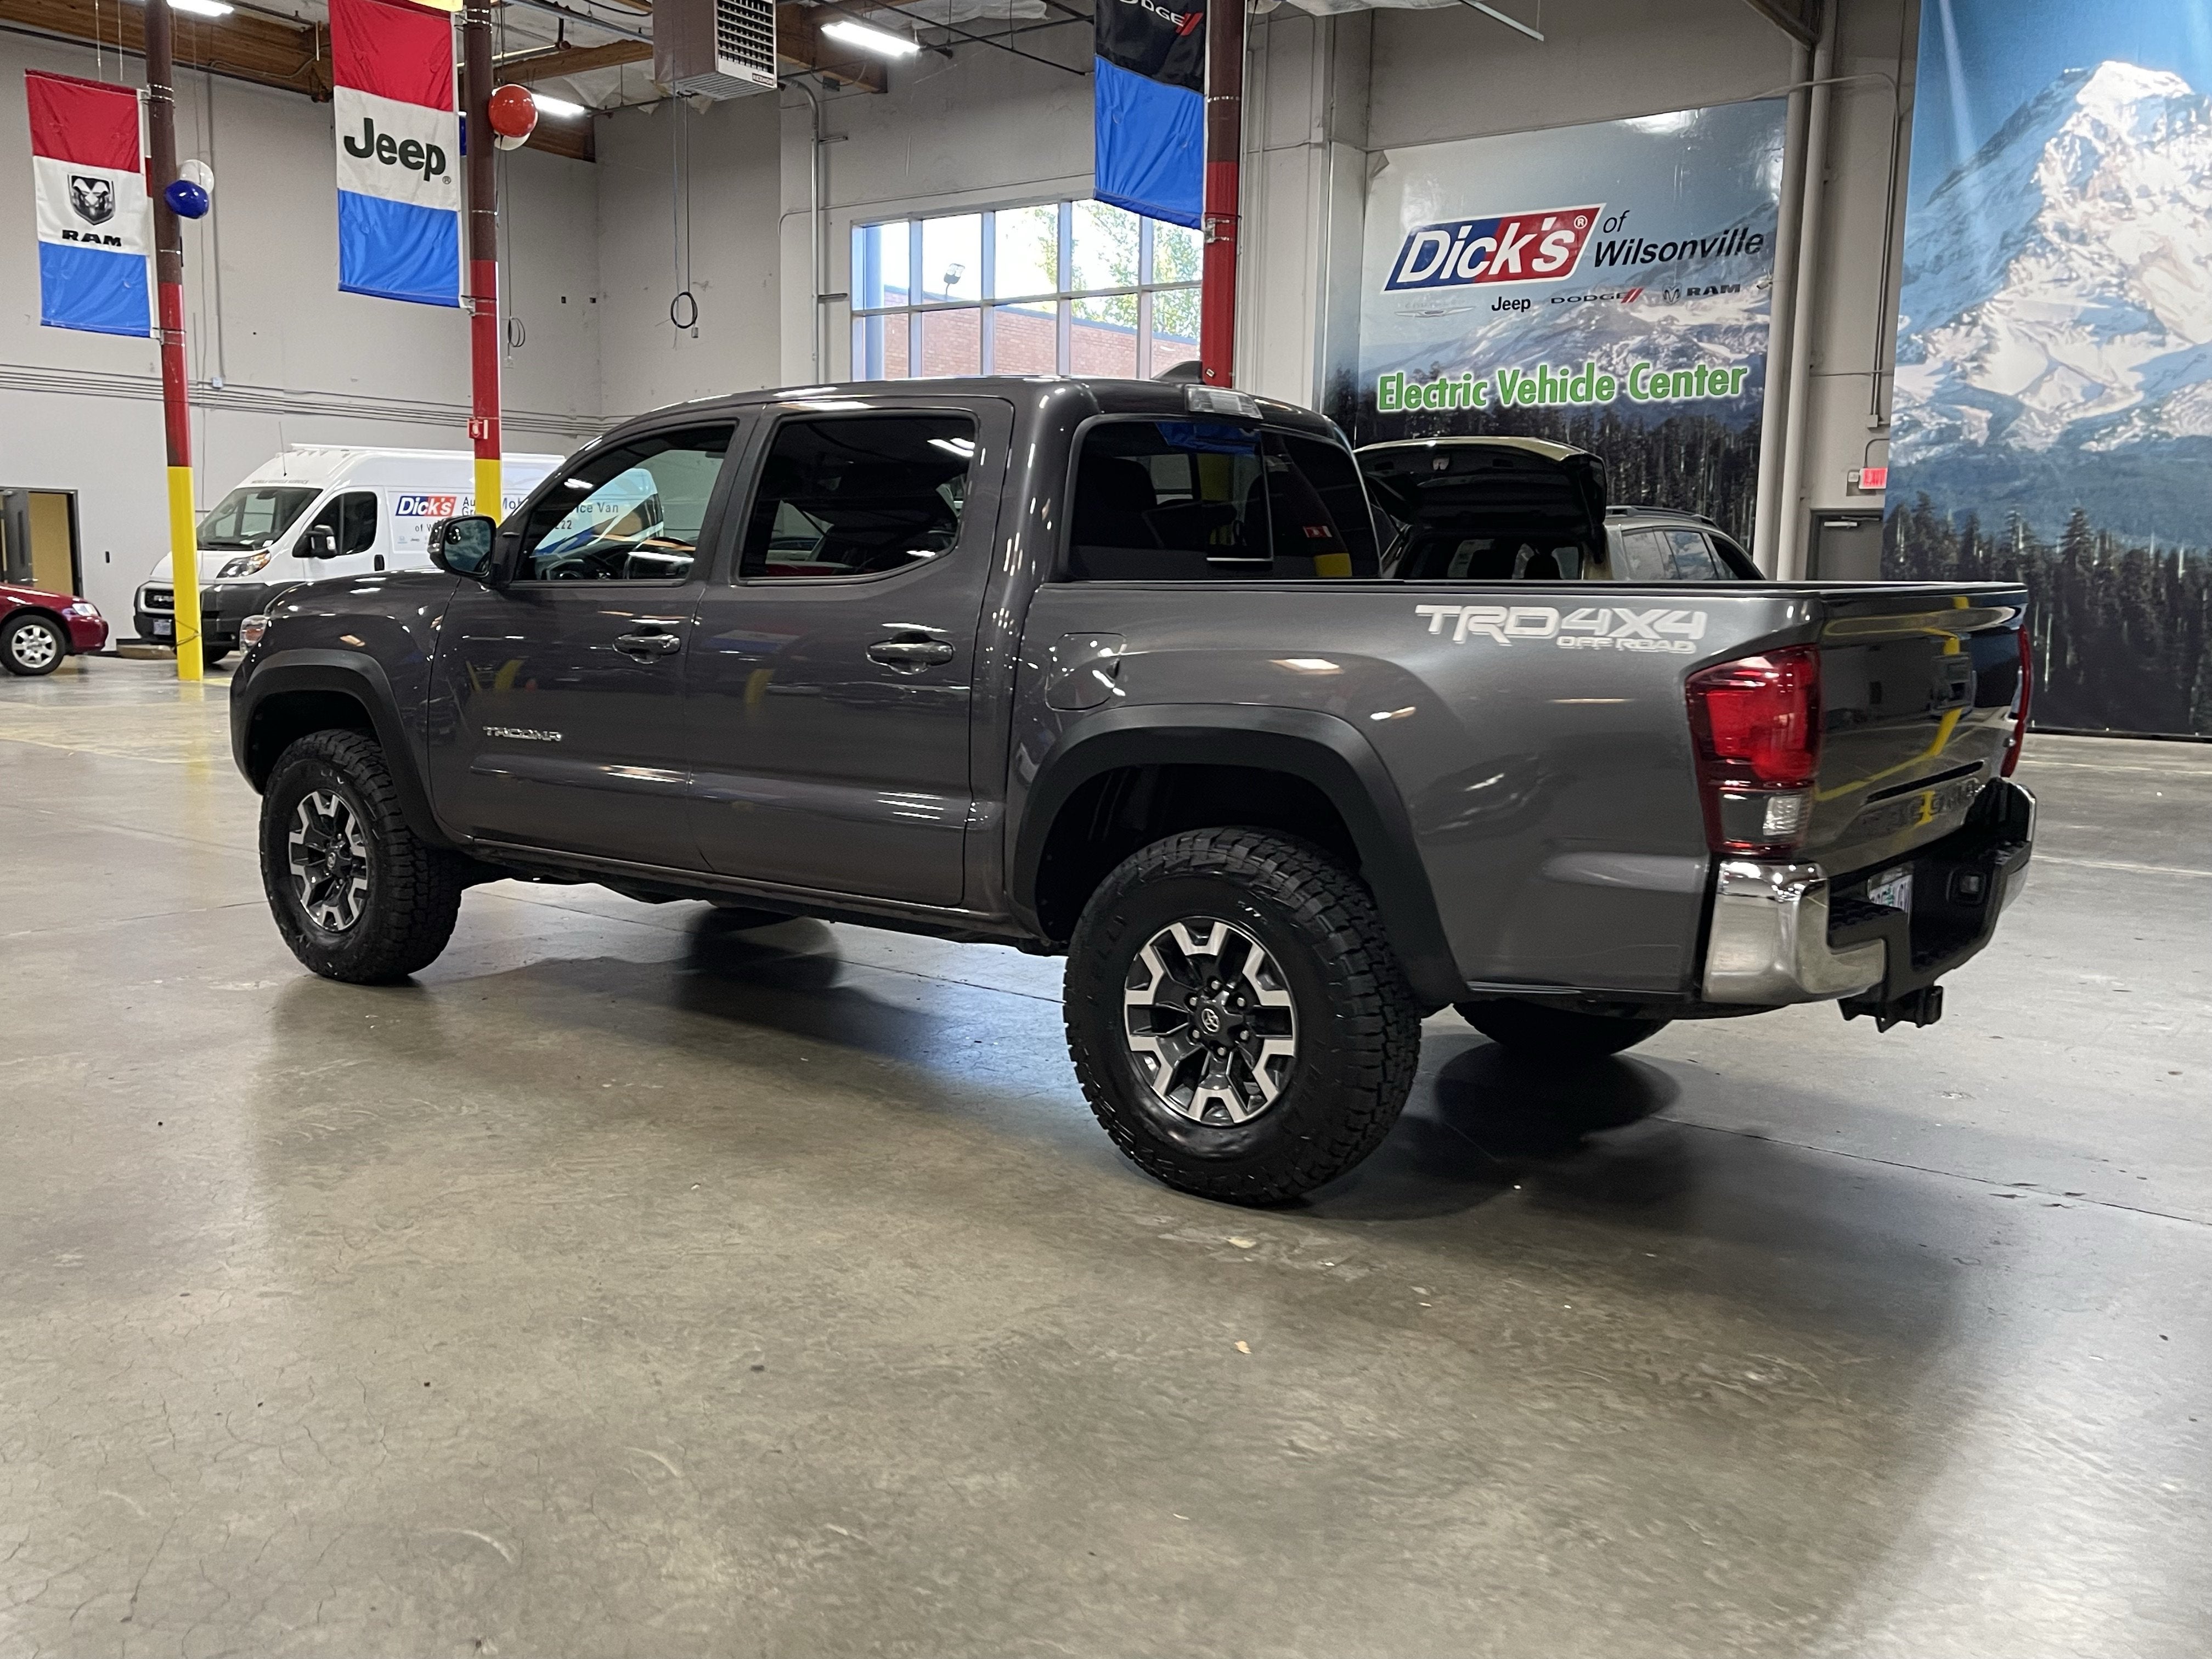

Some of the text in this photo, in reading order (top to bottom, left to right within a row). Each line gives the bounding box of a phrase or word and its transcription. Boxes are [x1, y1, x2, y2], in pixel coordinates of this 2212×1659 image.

[344, 117, 446, 182] Jeep
[62, 229, 121, 246] RAM
[1396, 210, 1630, 283] Dick's of
[1594, 228, 1764, 268] Wilsonville
[1551, 292, 1627, 304] DODGE
[1687, 284, 1740, 296] RAM
[1491, 297, 1531, 313] Jeep
[1379, 363, 1748, 410] Electric Vehicle Center
[398, 496, 454, 516] Dick's
[596, 502, 618, 513] Van
[415, 523, 423, 532] of
[1415, 605, 1560, 646] TRD
[1556, 636, 1696, 654] OFF ROAD
